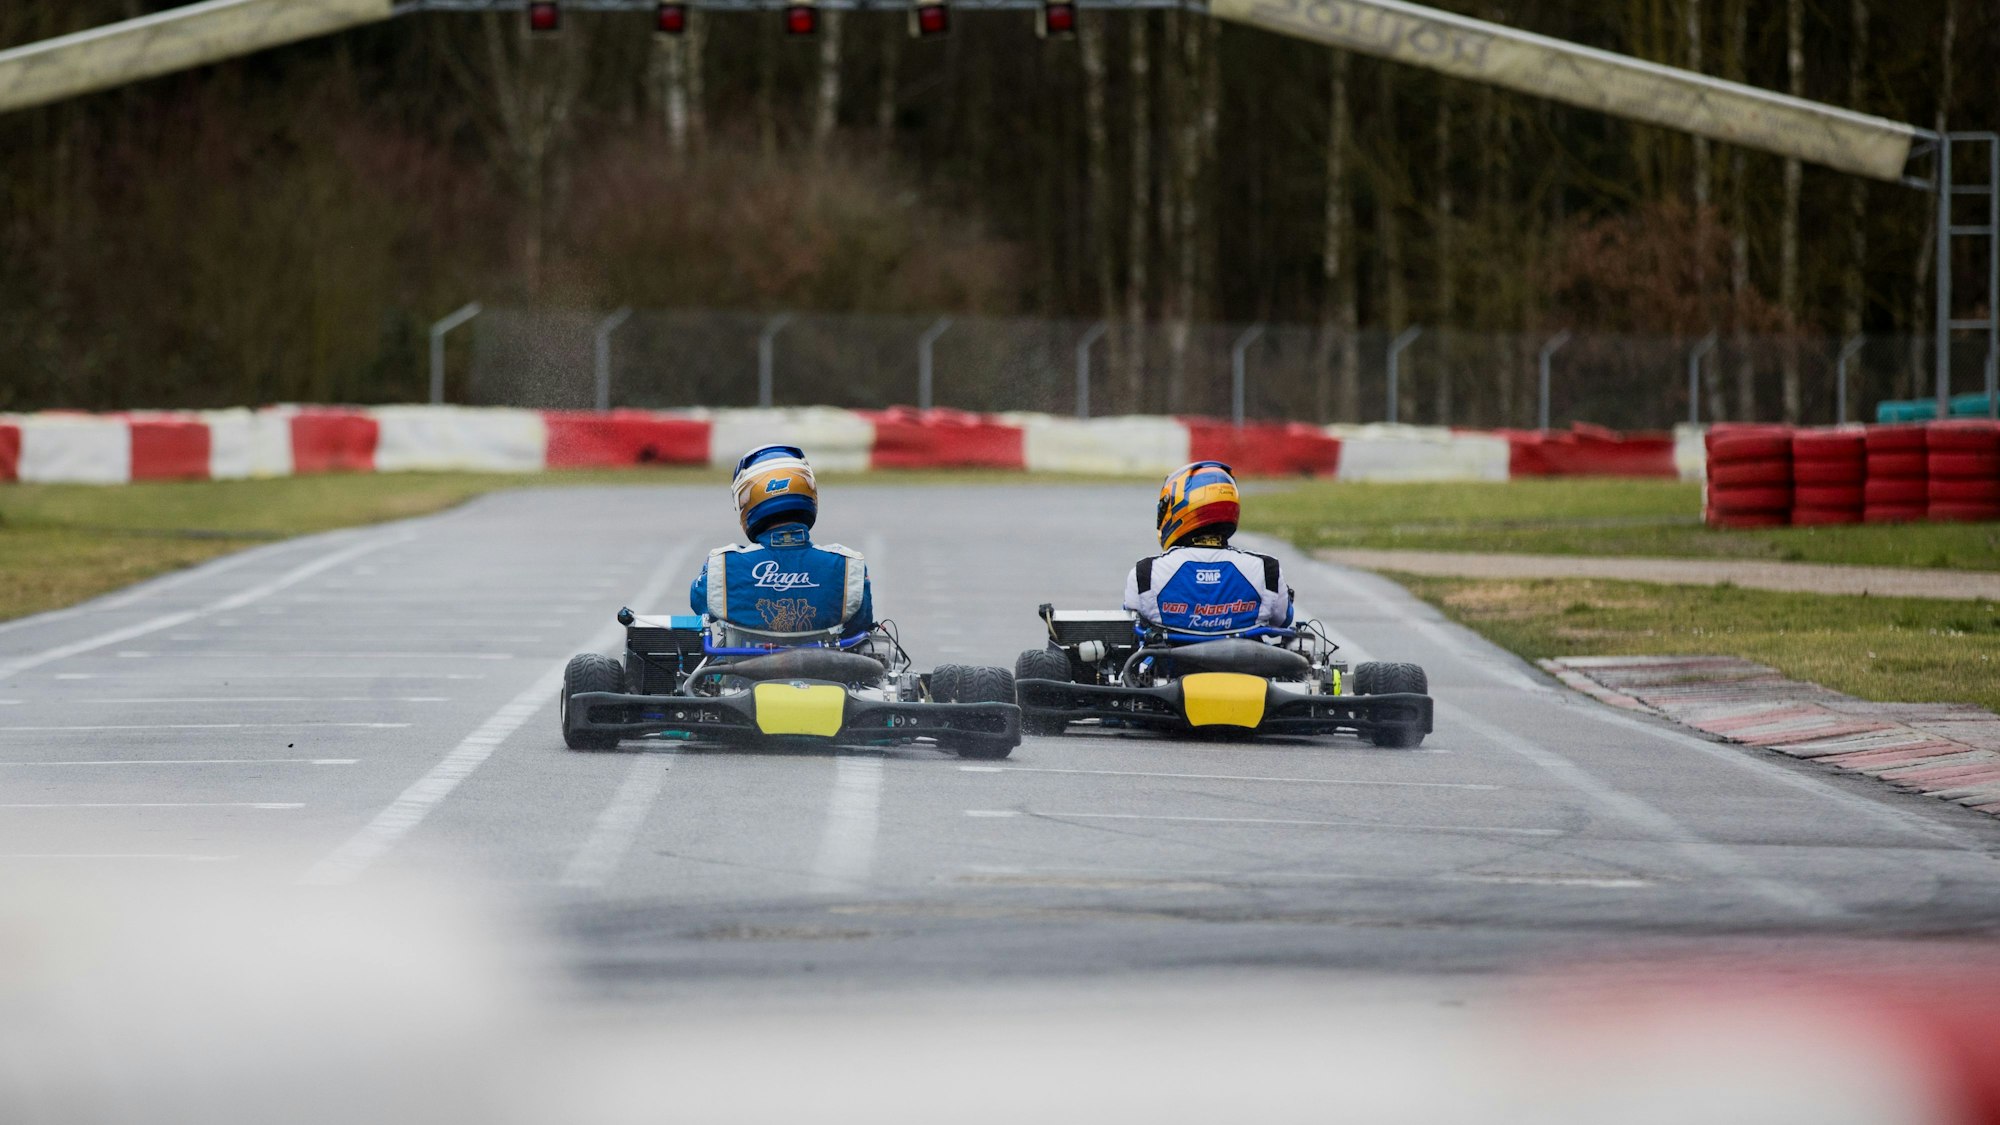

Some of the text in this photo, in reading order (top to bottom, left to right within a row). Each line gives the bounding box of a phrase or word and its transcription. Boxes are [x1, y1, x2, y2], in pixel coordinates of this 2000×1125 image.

[752, 560, 820, 592] Praga
[1196, 572, 1221, 582] OMP
[1162, 601, 1188, 613] van
[1188, 614, 1232, 628] Racing
